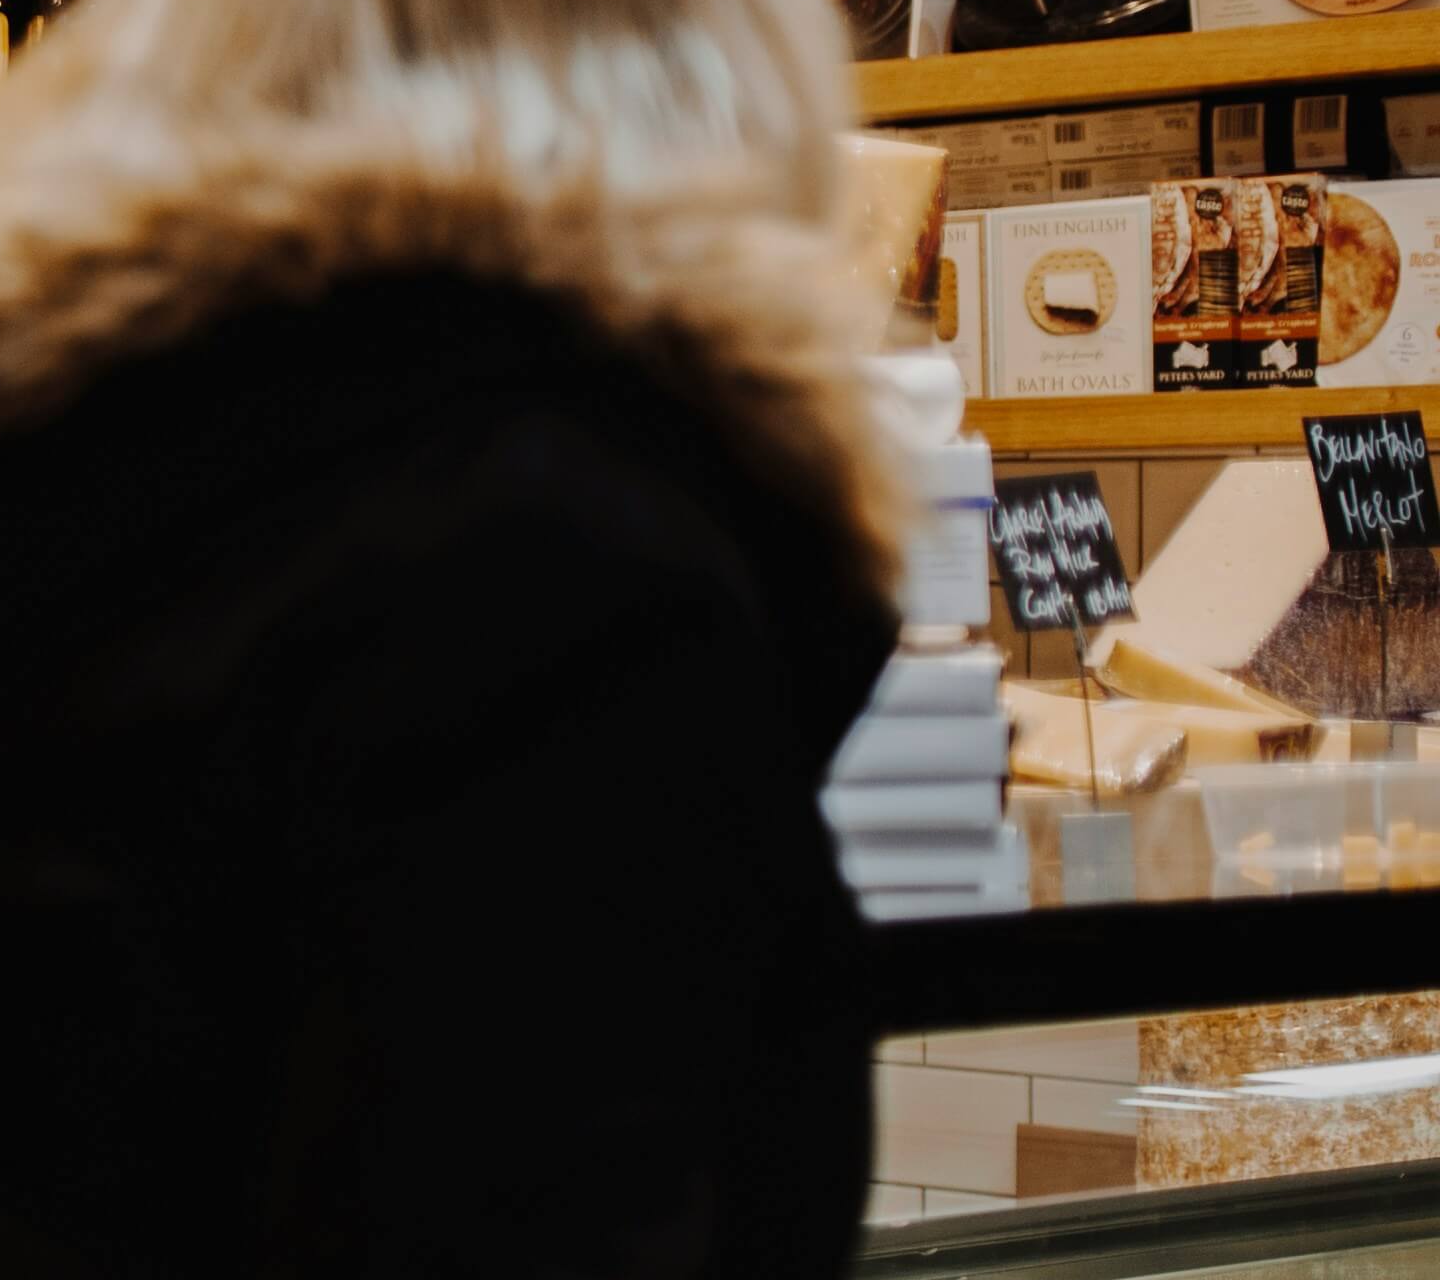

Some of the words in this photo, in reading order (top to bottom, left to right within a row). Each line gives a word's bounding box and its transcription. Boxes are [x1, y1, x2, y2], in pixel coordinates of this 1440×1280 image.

[1013, 222, 1048, 239] FINE
[1055, 217, 1128, 236] ENGLISH
[1017, 376, 1065, 394] BATH
[1070, 373, 1132, 392] OVALS
[1338, 469, 1426, 542] MERLOT
